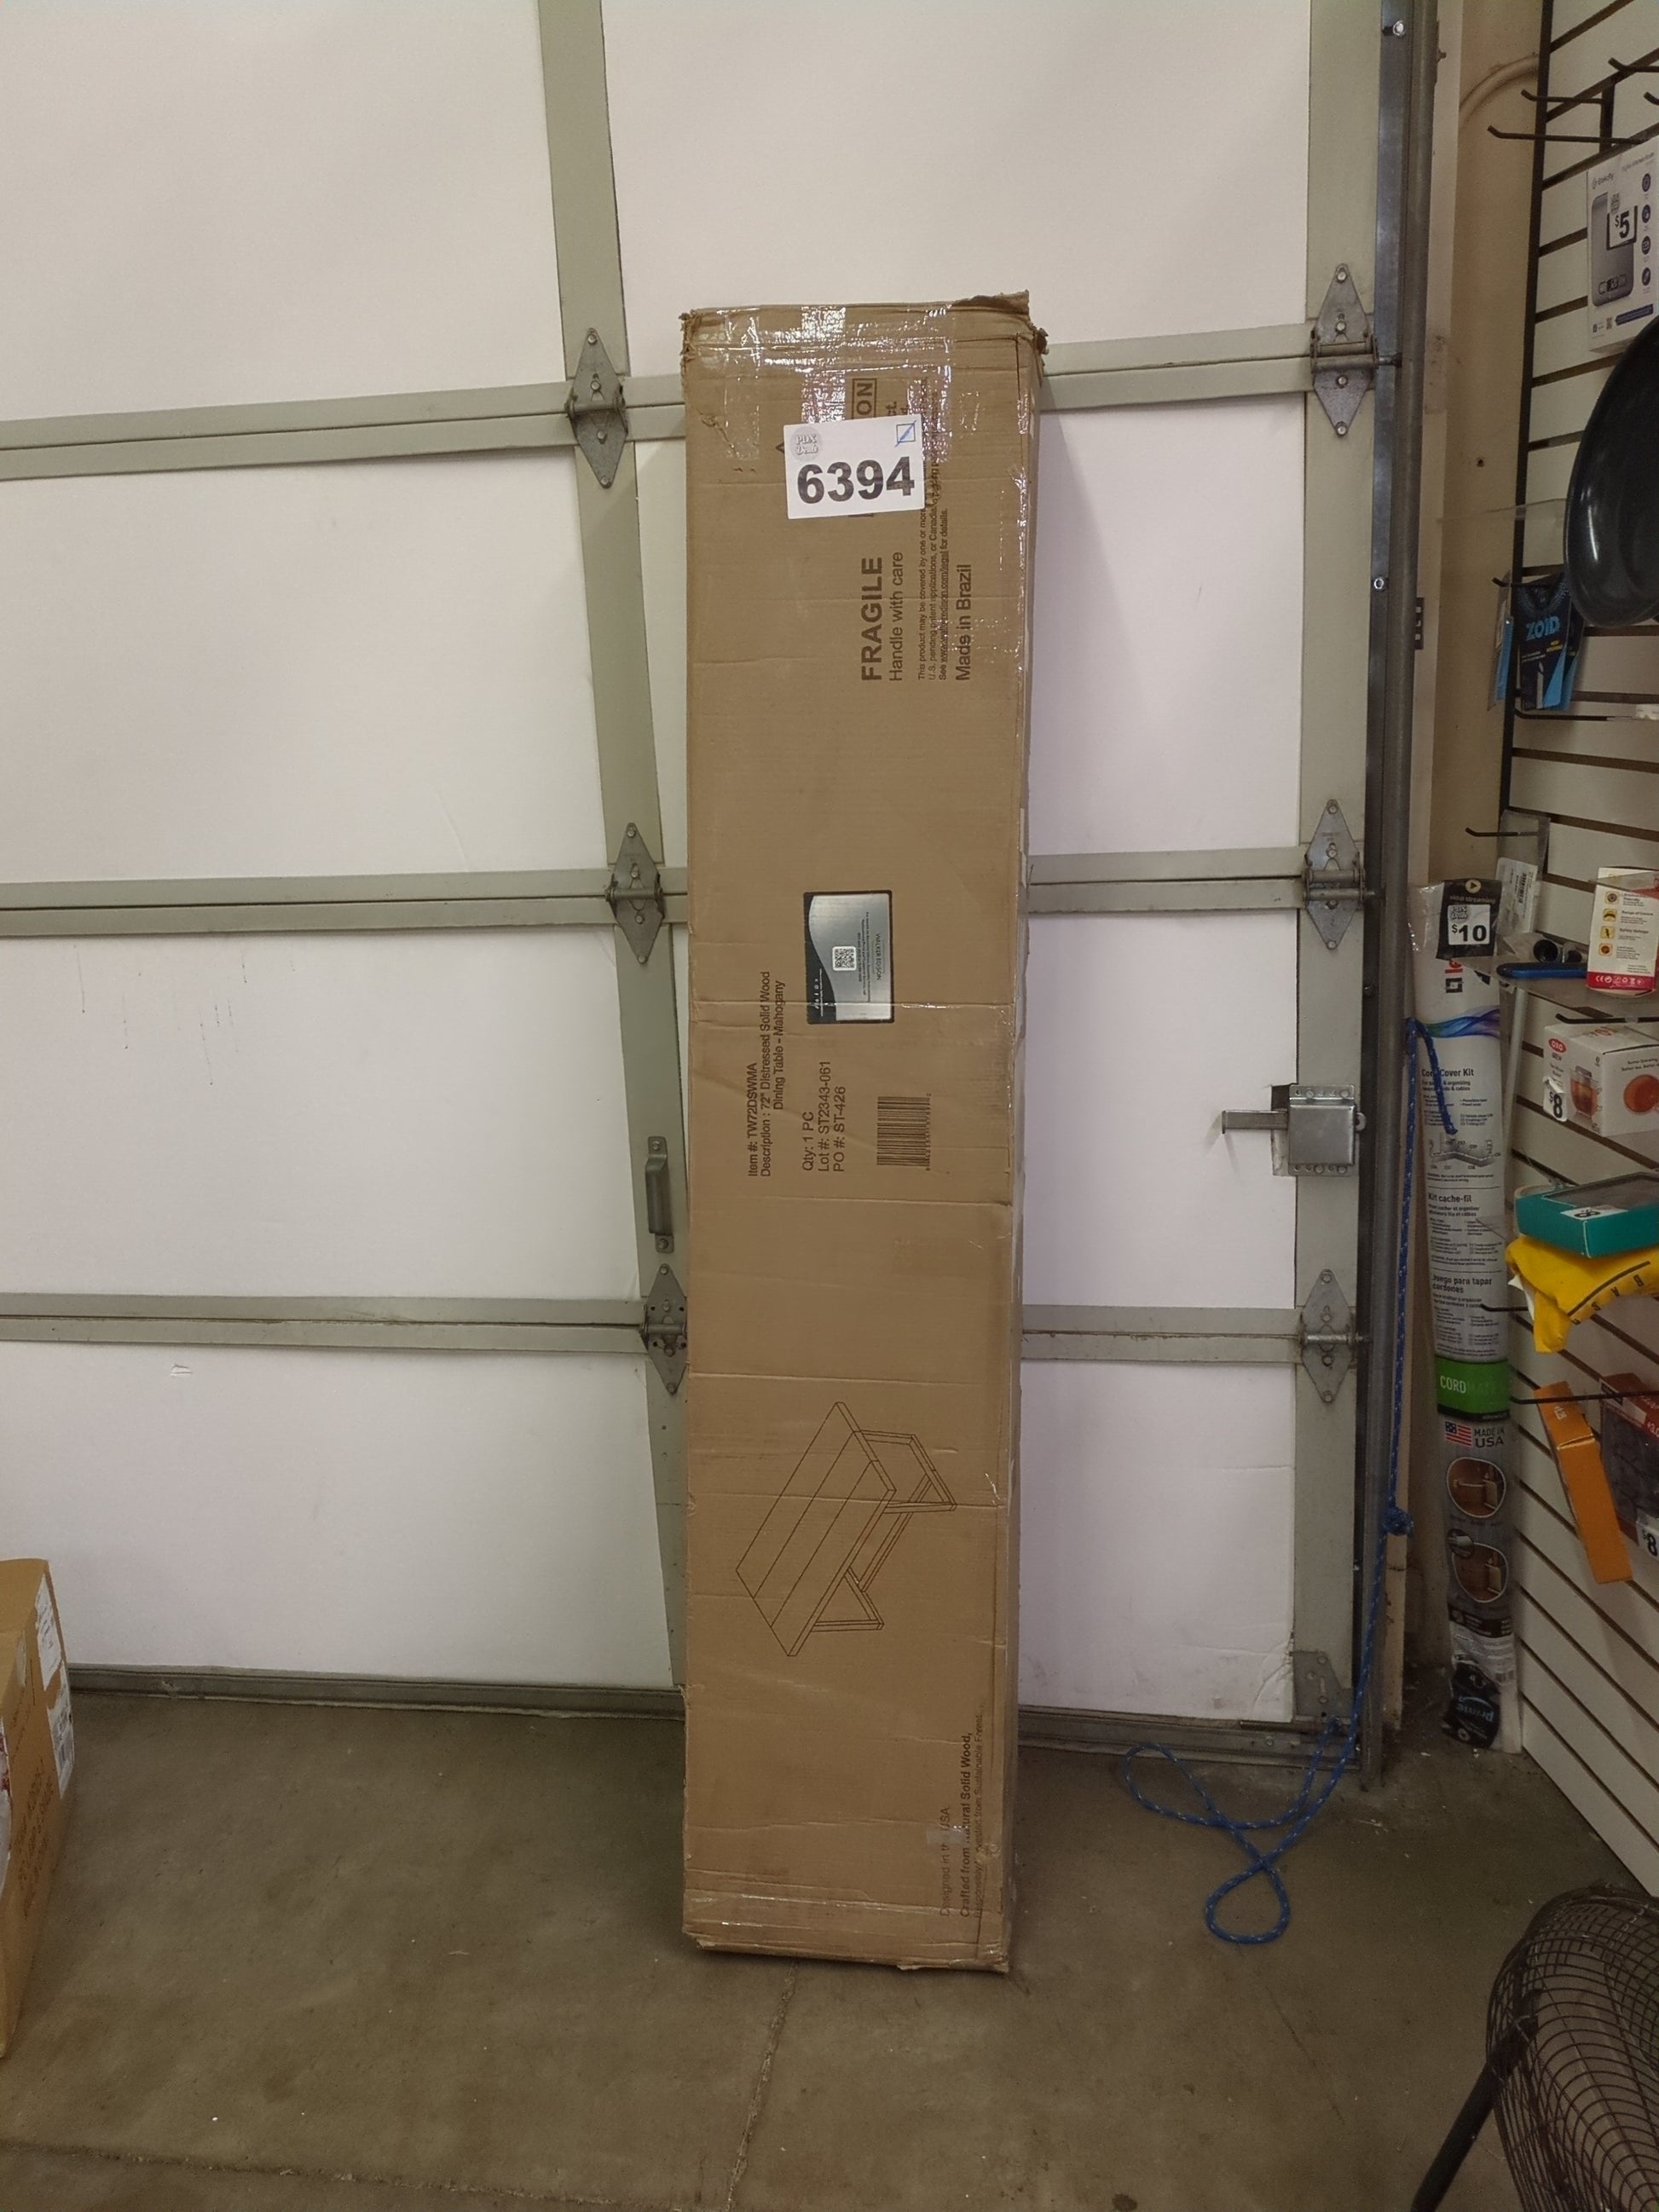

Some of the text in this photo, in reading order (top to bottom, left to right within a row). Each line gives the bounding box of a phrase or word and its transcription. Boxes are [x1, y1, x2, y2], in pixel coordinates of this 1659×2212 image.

[797, 456, 915, 505] 6394
[861, 557, 882, 680] FRAGILE
[889, 552, 903, 681] Handle with care
[919, 603, 926, 611] be
[956, 564, 971, 680] Made in Brazil
[1526, 616, 1560, 641] ZOID
[1452, 924, 1487, 942] $10
[760, 972, 770, 1002] Wood
[760, 1005, 770, 1031] Solid
[774, 981, 785, 1036] Mahogany
[760, 1035, 771, 1089] Distressed
[773, 1046, 783, 1074] Table
[760, 1093, 771, 1110] 72"
[774, 1077, 785, 1109] Dining
[747, 1063, 758, 1176] Item #: TW72DSWMA
[803, 1112, 814, 1131] PC
[818, 1061, 830, 1171] Lot #: ST2343-061
[834, 1087, 845, 1172] PO #: ST-426
[760, 1119, 772, 1176] Description
[802, 1147, 814, 1171] Qty:
[1474, 1428, 1495, 1436] MADE
[1476, 1436, 1504, 1447] USA
[961, 1733, 973, 1768] Wood,
[960, 1772, 970, 1799] Solid
[940, 1855, 949, 1863] in
[960, 1848, 970, 1873] from
[960, 1876, 970, 1917] Crafted
